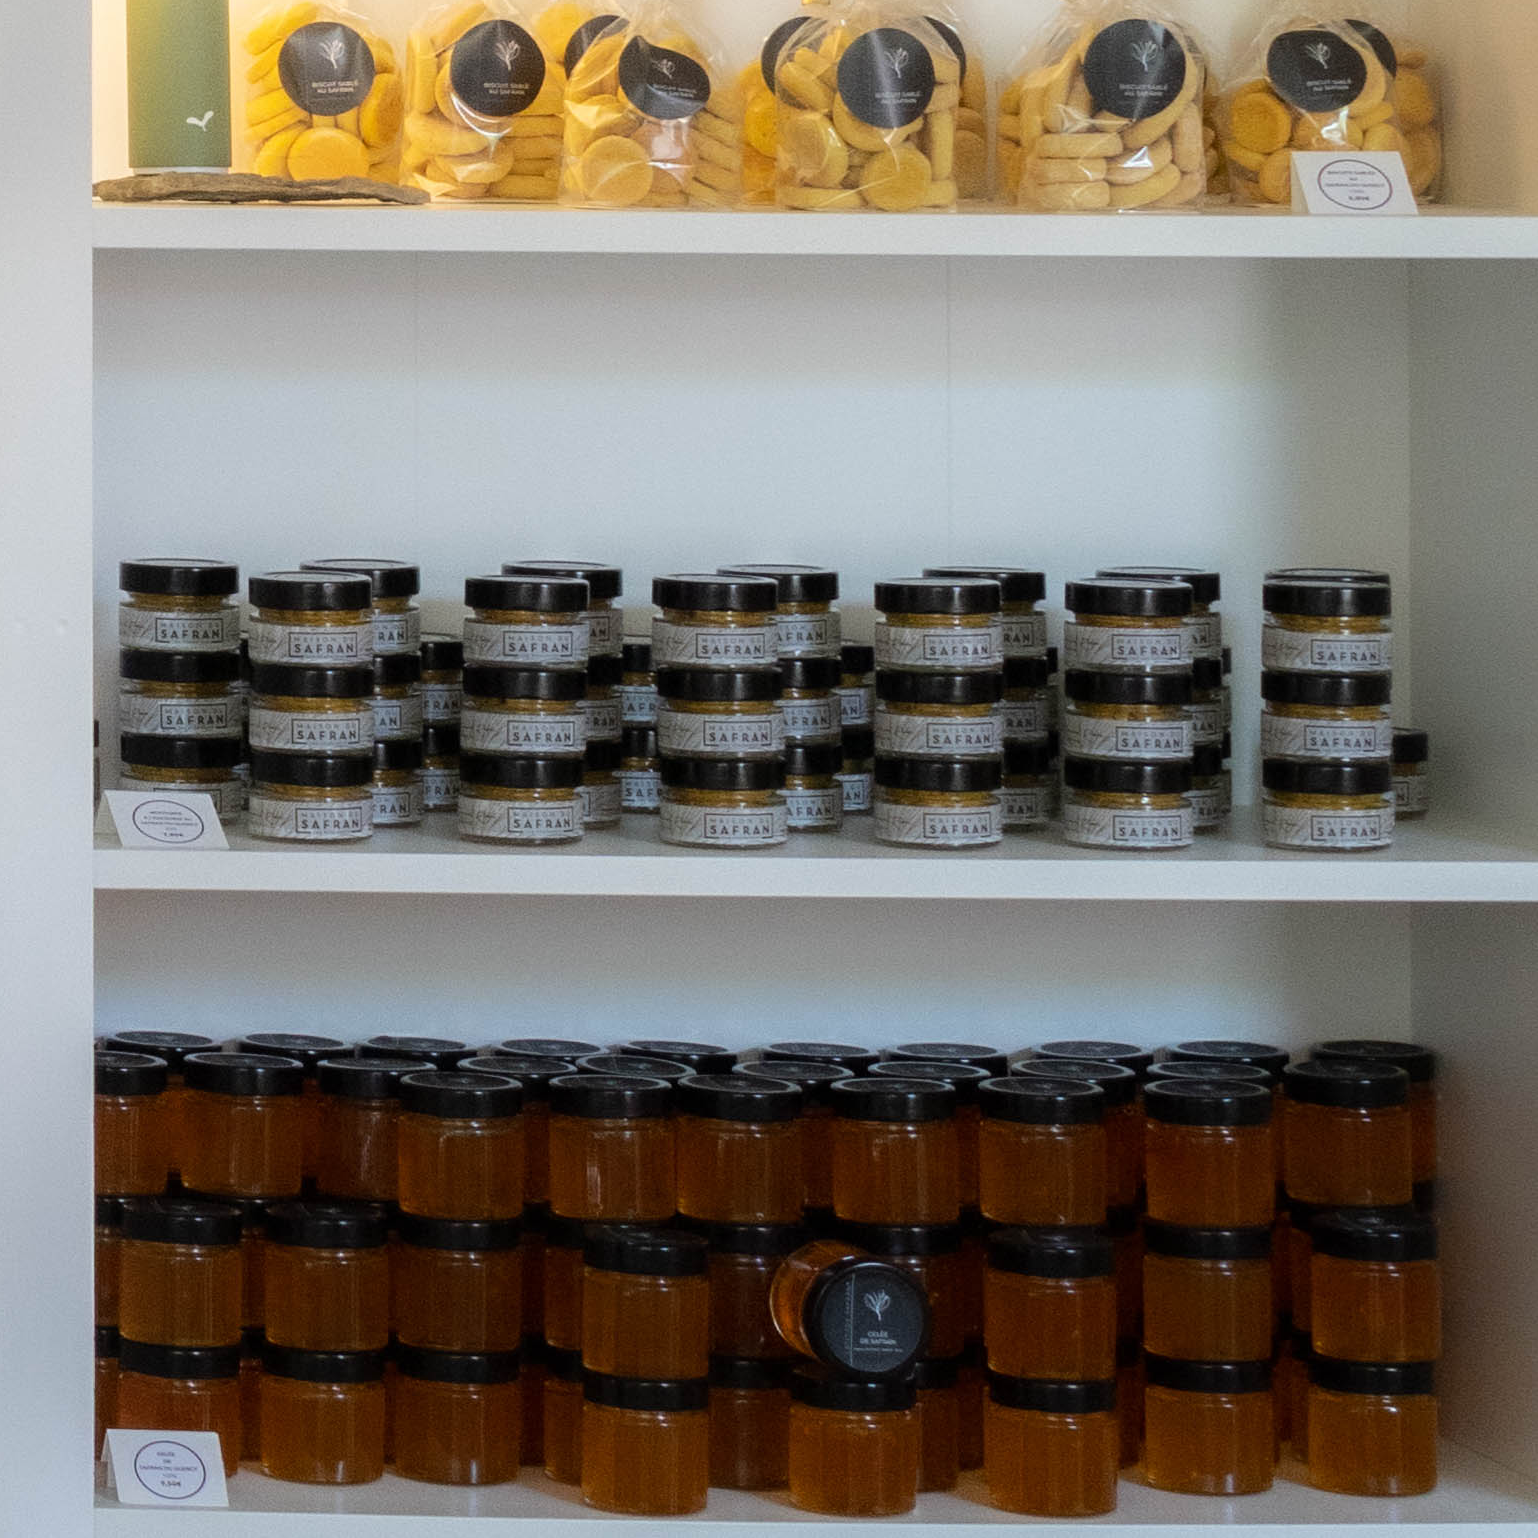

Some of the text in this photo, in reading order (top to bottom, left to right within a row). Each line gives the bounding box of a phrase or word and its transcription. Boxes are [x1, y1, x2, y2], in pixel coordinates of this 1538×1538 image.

[161, 628, 221, 639] SAFRAN
[294, 643, 354, 654] SAFRAN
[509, 642, 570, 653] SAFRAN
[701, 645, 763, 655] SAFRAN
[930, 645, 989, 656] SAFRAN
[1118, 645, 1179, 656] SAFRAN
[297, 729, 357, 740] SAFRAN
[513, 732, 572, 743] SAFRAN
[1122, 737, 1181, 748] SAFRAN
[301, 818, 360, 829] SAFRAN
